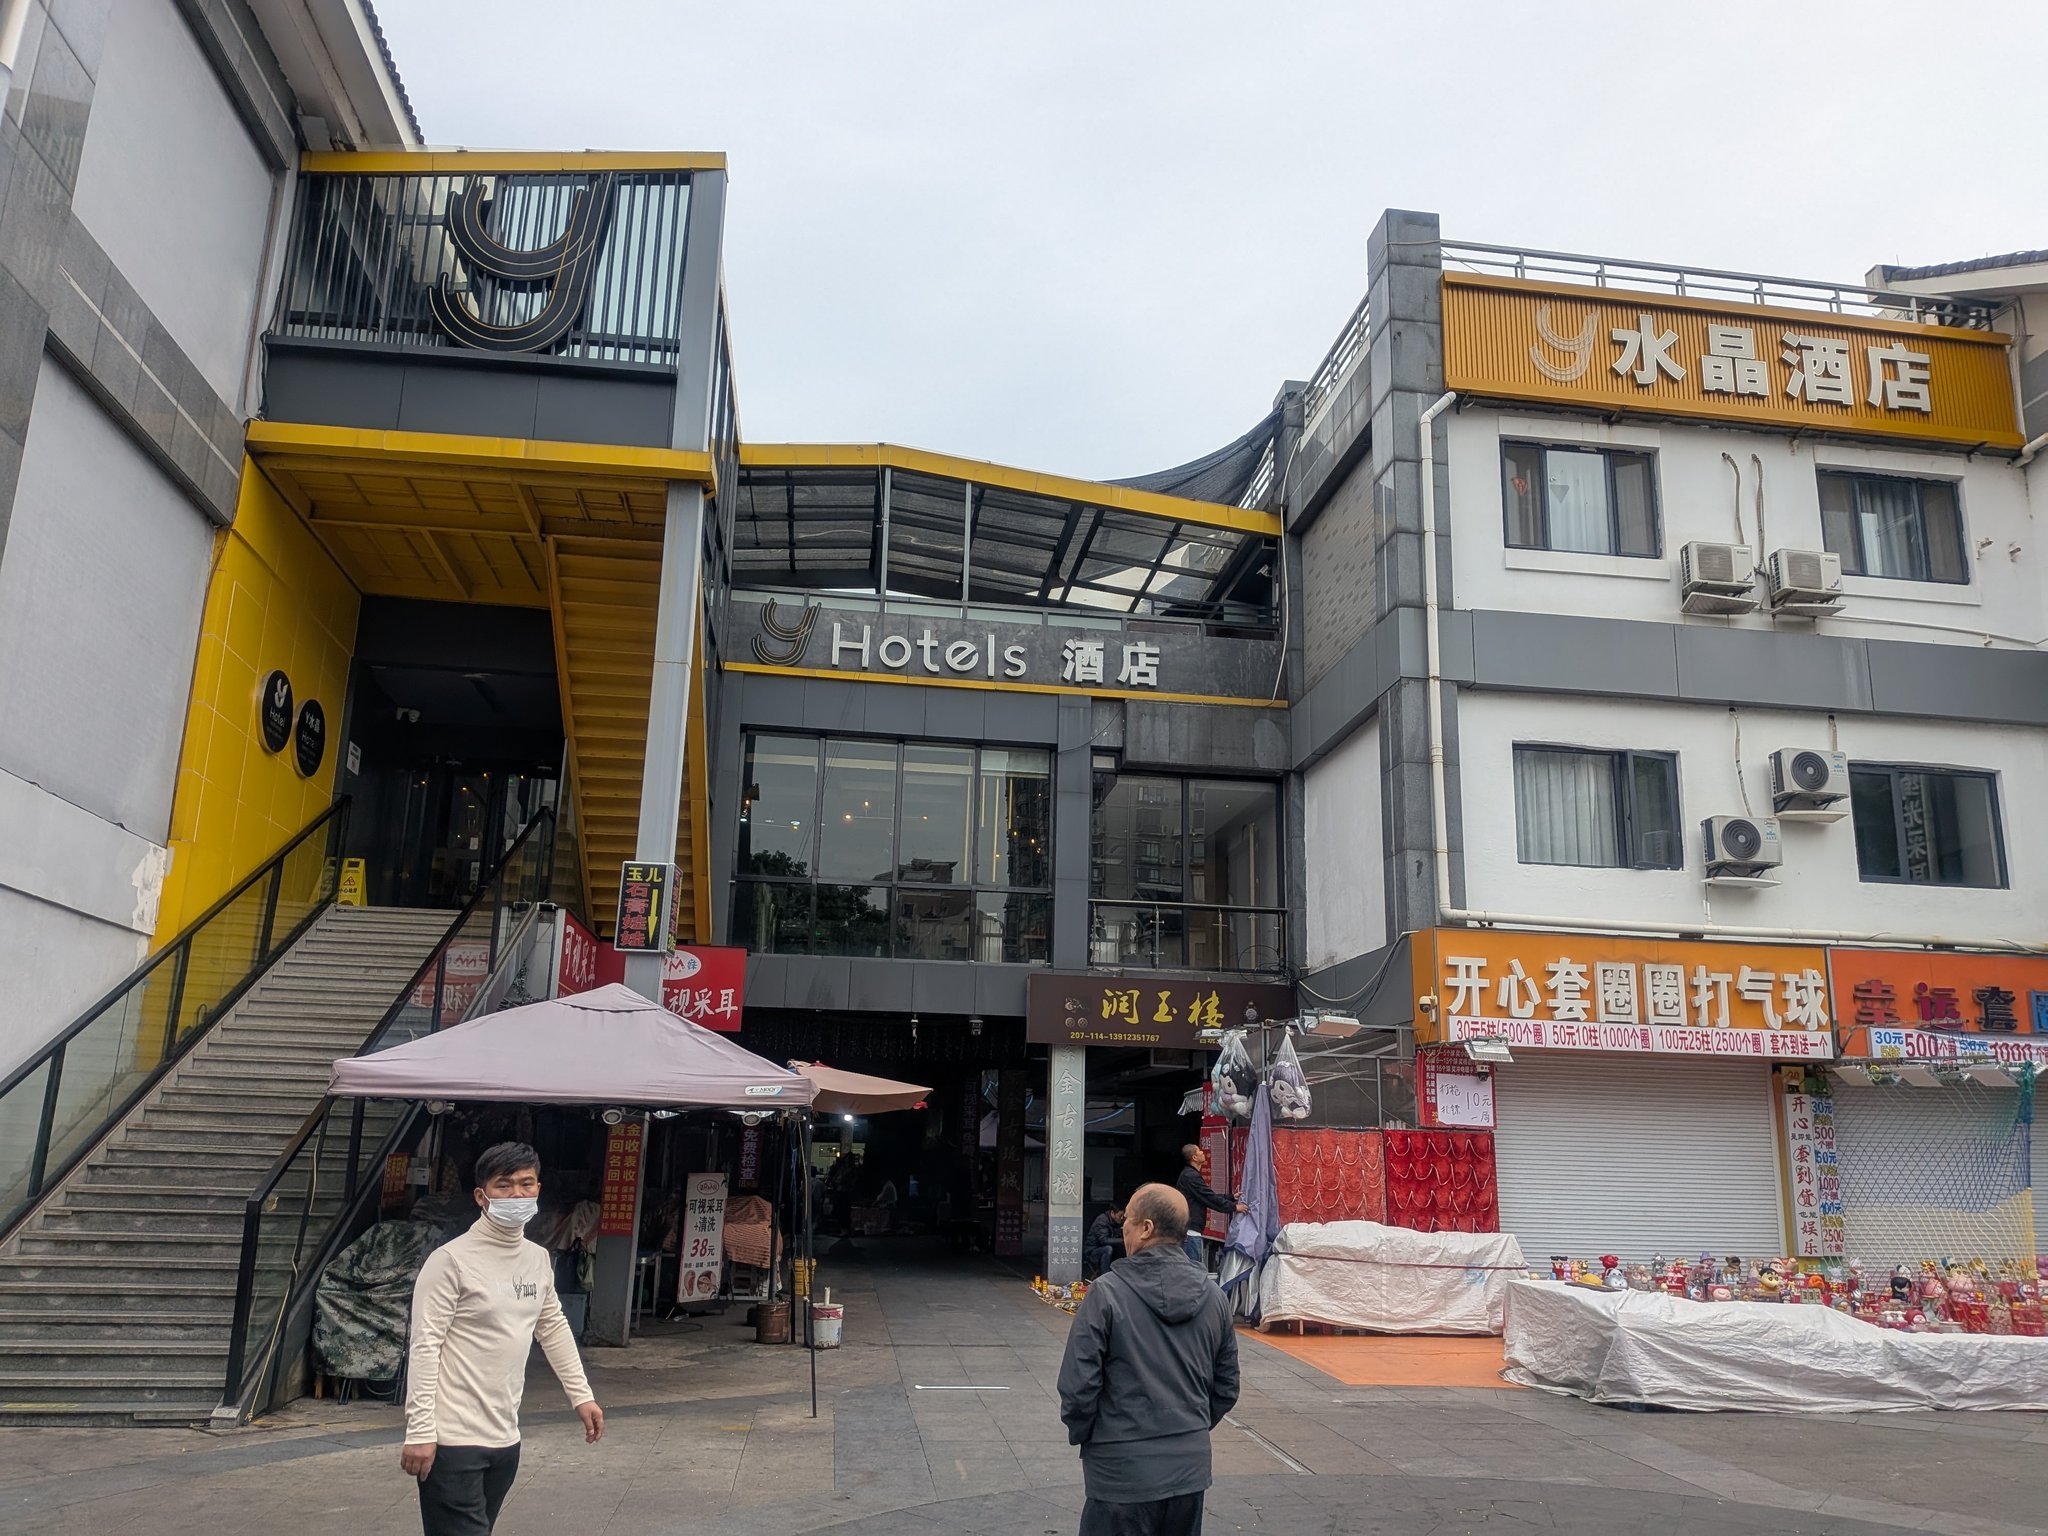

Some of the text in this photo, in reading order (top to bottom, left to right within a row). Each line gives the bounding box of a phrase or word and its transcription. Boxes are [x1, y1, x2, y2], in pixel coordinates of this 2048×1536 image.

[1612, 314, 1931, 412] 水晶酒店
[832, 623, 1027, 677] Hotels
[1062, 638, 1160, 686] 酒店
[269, 706, 286, 728] Hotel
[627, 867, 662, 882] 玉儿
[620, 882, 651, 947] 石膏娃娃
[565, 924, 598, 989] 可视采耳
[663, 986, 739, 1020] 视采耳
[1444, 956, 1829, 1031] 开心套圈圈打气球
[1101, 988, 1225, 1028] 润玉楼
[1769, 1033, 1828, 1057] 套不到送一个
[1874, 1031, 1904, 1046] 30元
[1466, 1091, 1492, 1110] 10元
[1811, 1101, 1833, 1114] 30元
[1814, 1126, 1835, 1140] 500
[609, 1139, 640, 1153] 回收
[740, 1129, 759, 1180] 免费检查
[608, 1155, 638, 1168] 名表
[607, 1169, 636, 1182] 回收
[689, 1198, 724, 1214] 可视采耳
[690, 1239, 715, 1258] 38元
